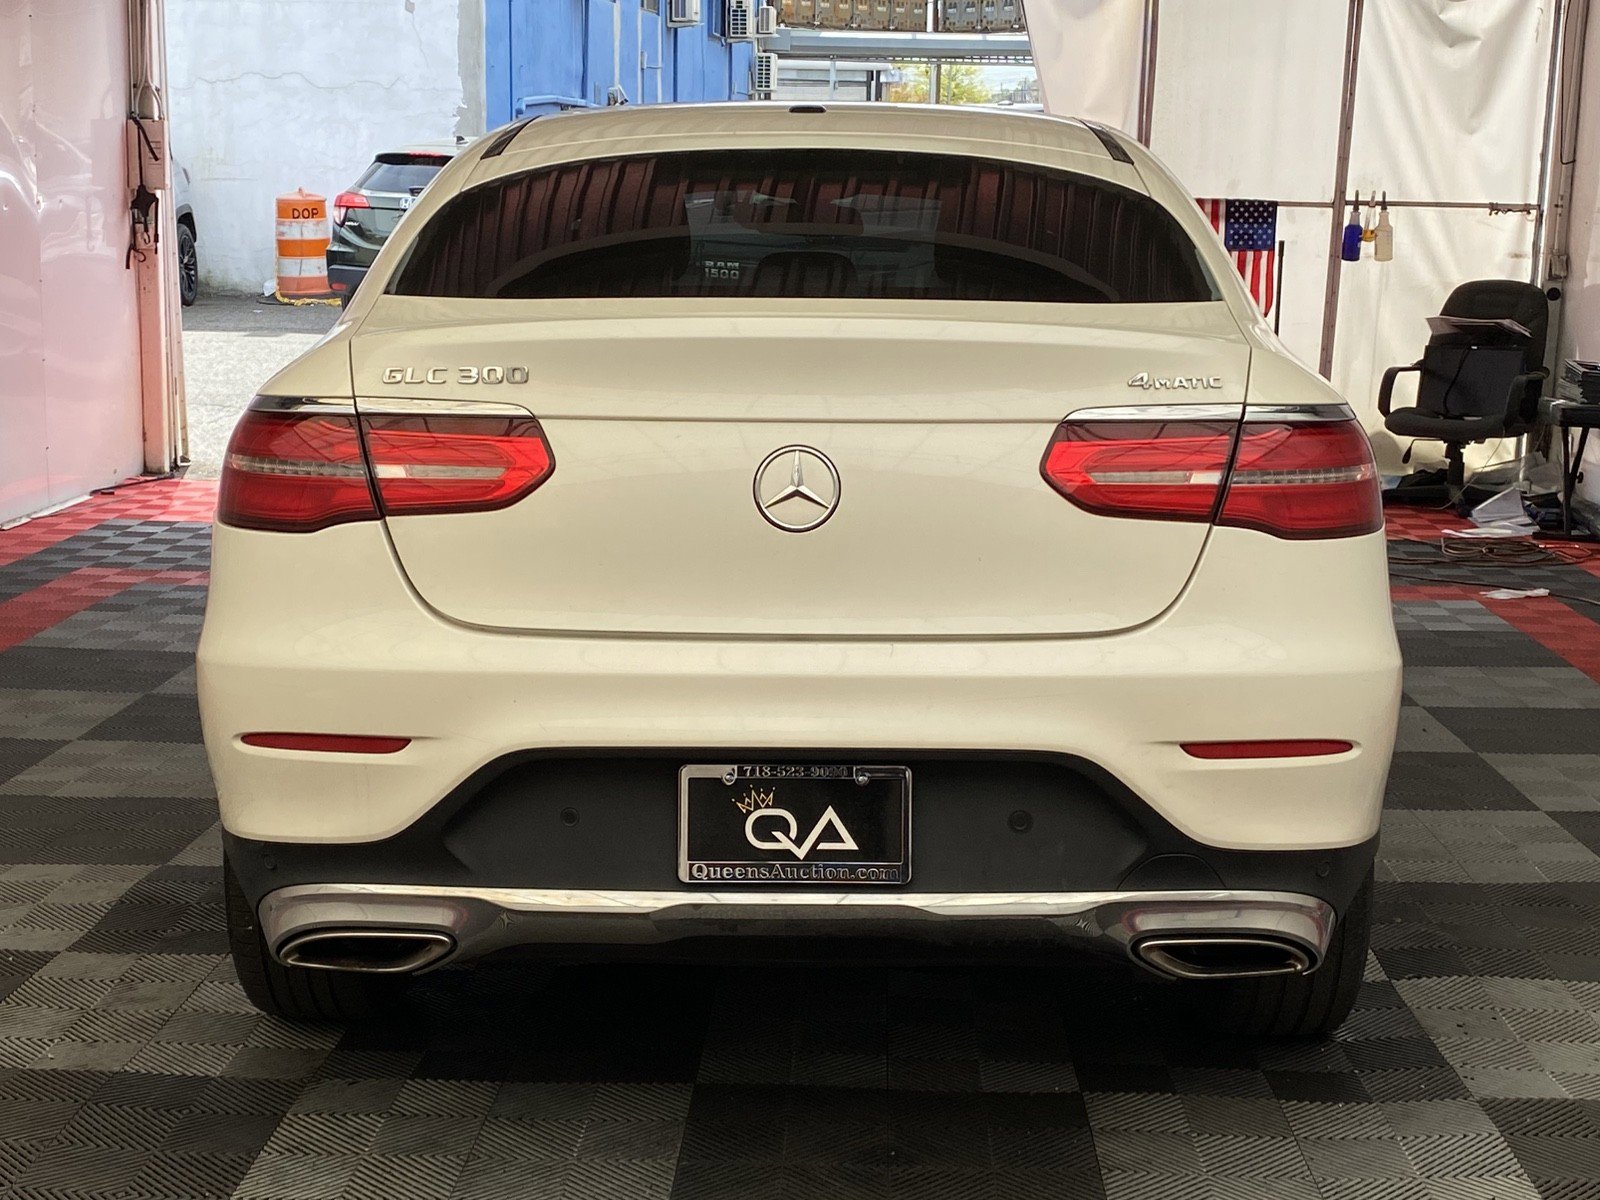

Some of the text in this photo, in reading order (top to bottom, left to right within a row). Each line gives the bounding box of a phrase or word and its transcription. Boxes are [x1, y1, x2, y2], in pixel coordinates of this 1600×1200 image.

[292, 208, 319, 219] DOP
[704, 260, 740, 269] RAM
[704, 268, 740, 279] 1500
[382, 366, 530, 385] GLC 300
[1128, 372, 1223, 390] 4MATIC
[691, 863, 900, 880] QueensAuction.com
